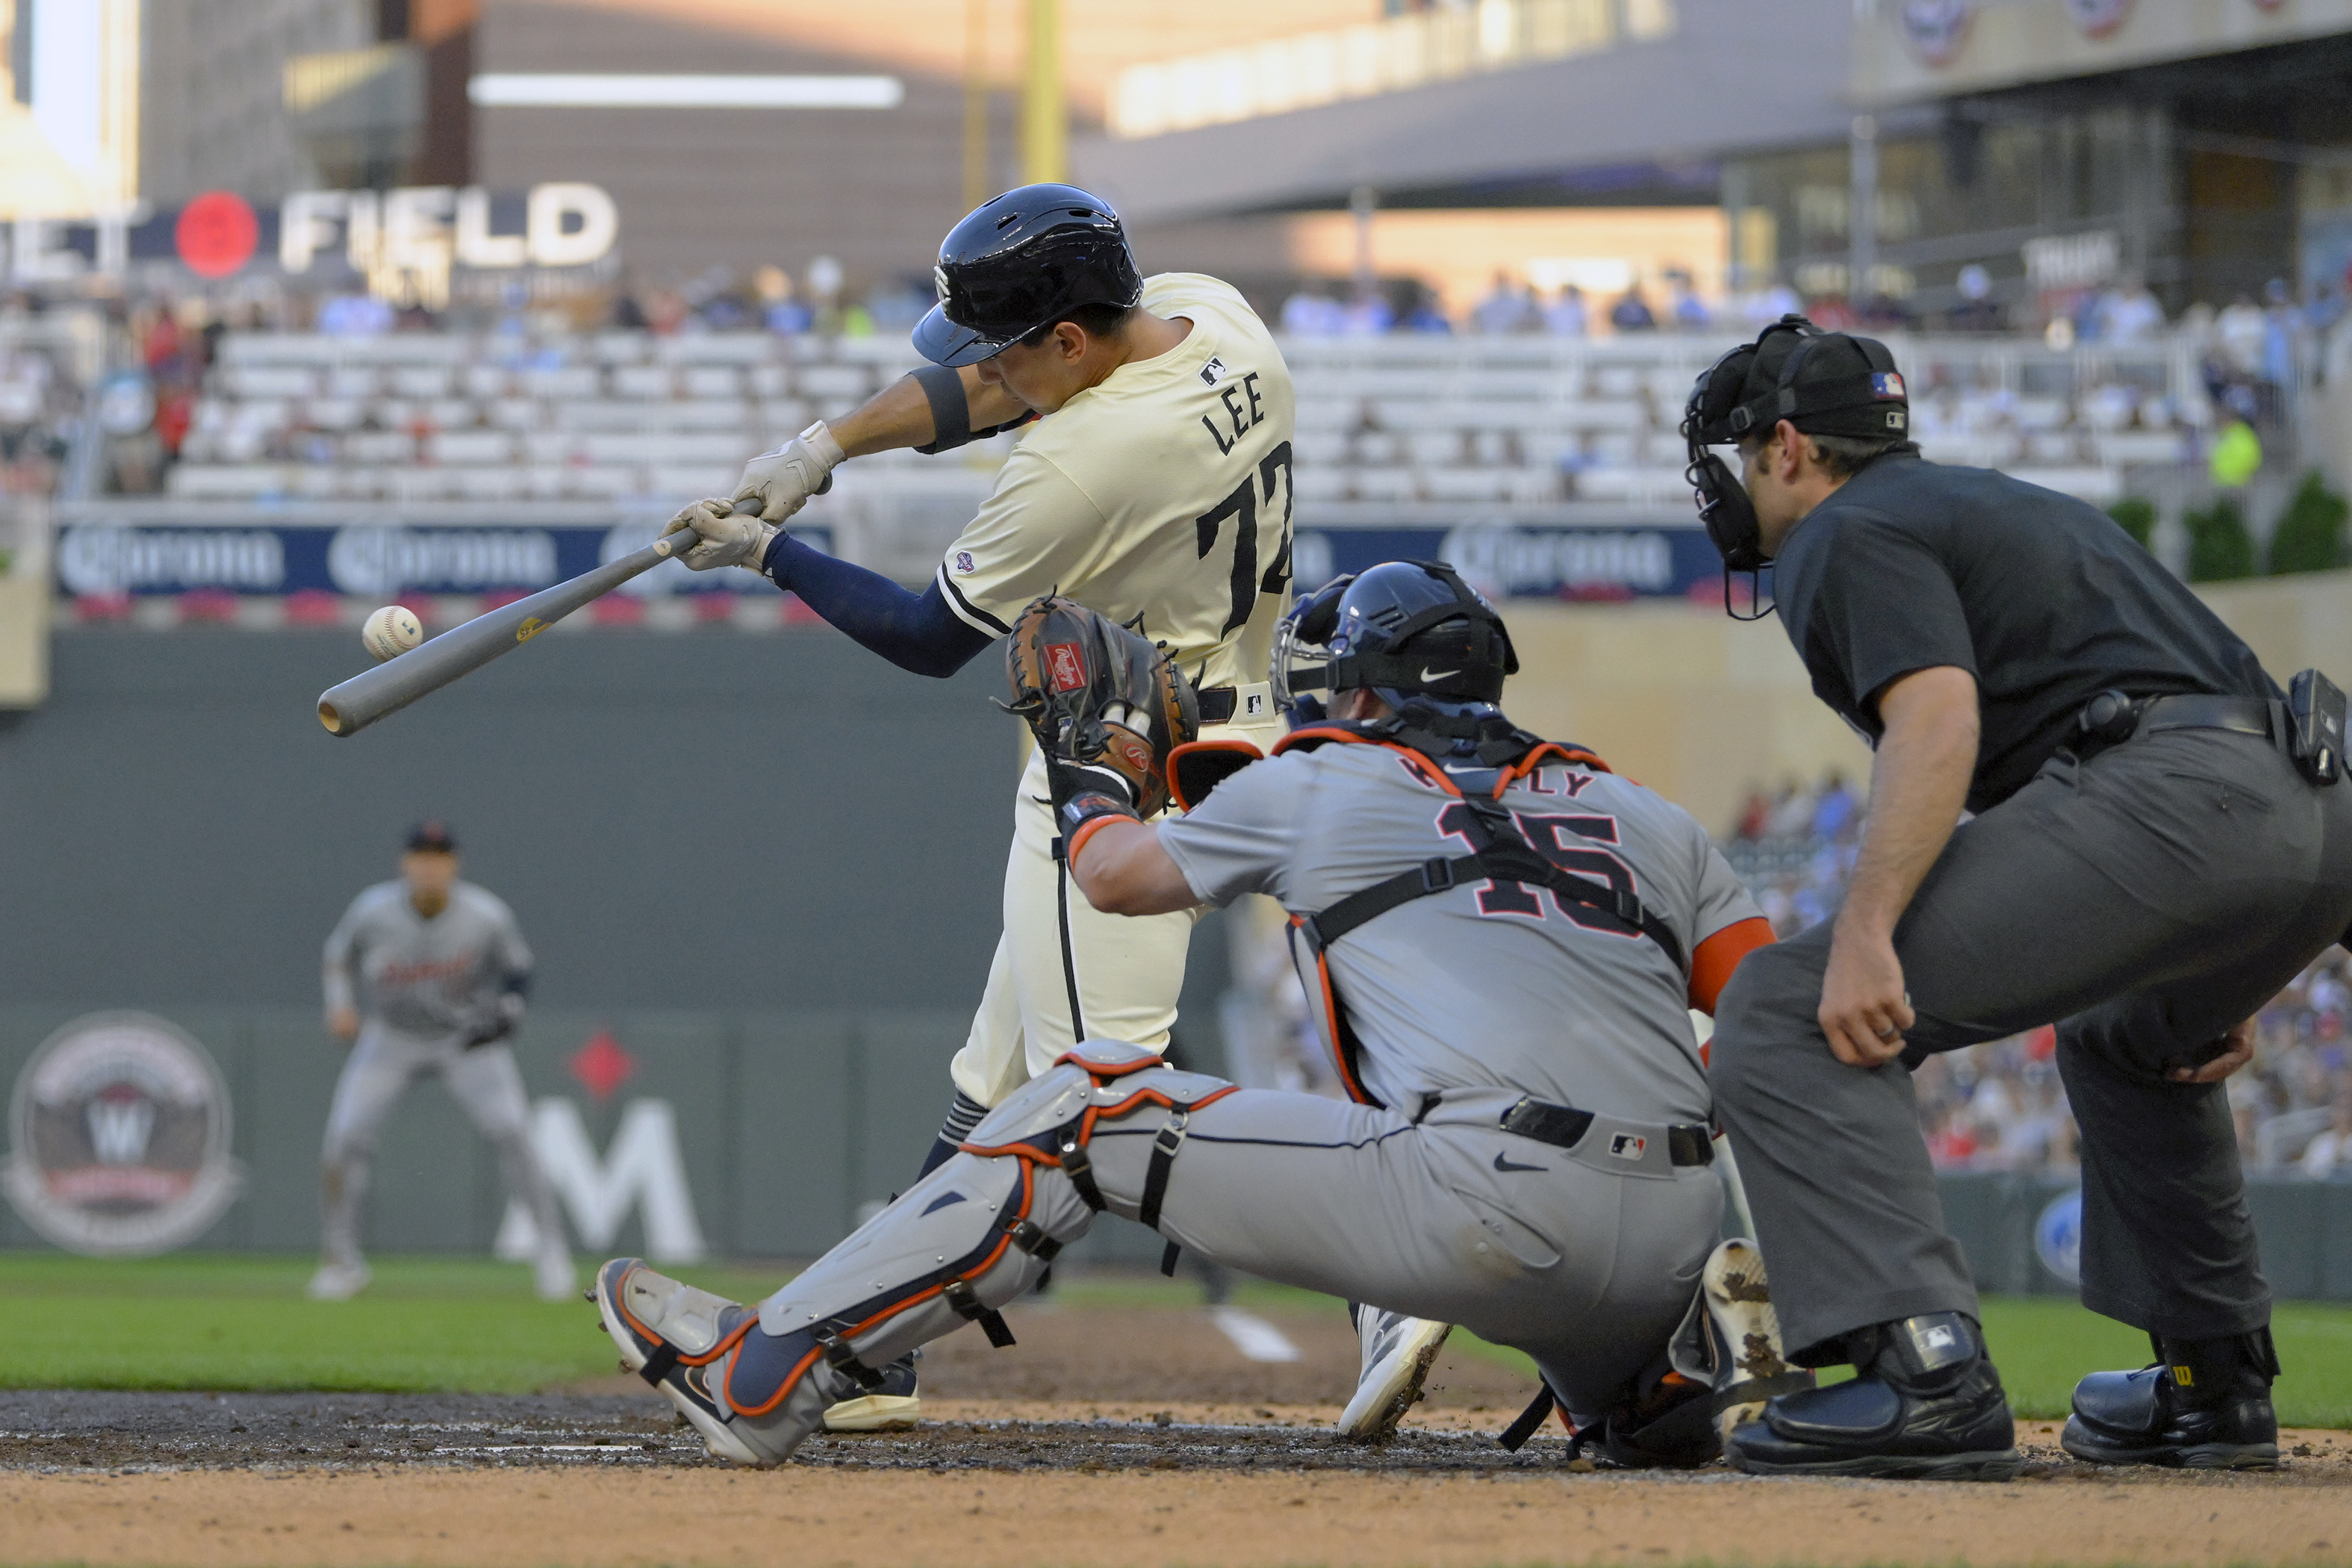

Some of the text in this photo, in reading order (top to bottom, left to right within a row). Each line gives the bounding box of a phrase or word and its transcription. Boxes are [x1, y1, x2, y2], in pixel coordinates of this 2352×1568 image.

[279, 182, 619, 273] FIELD
[1201, 371, 1264, 457] LEE
[1195, 441, 1293, 643] 72
[1396, 756, 1596, 799] KLY
[1434, 800, 1644, 941] 15
